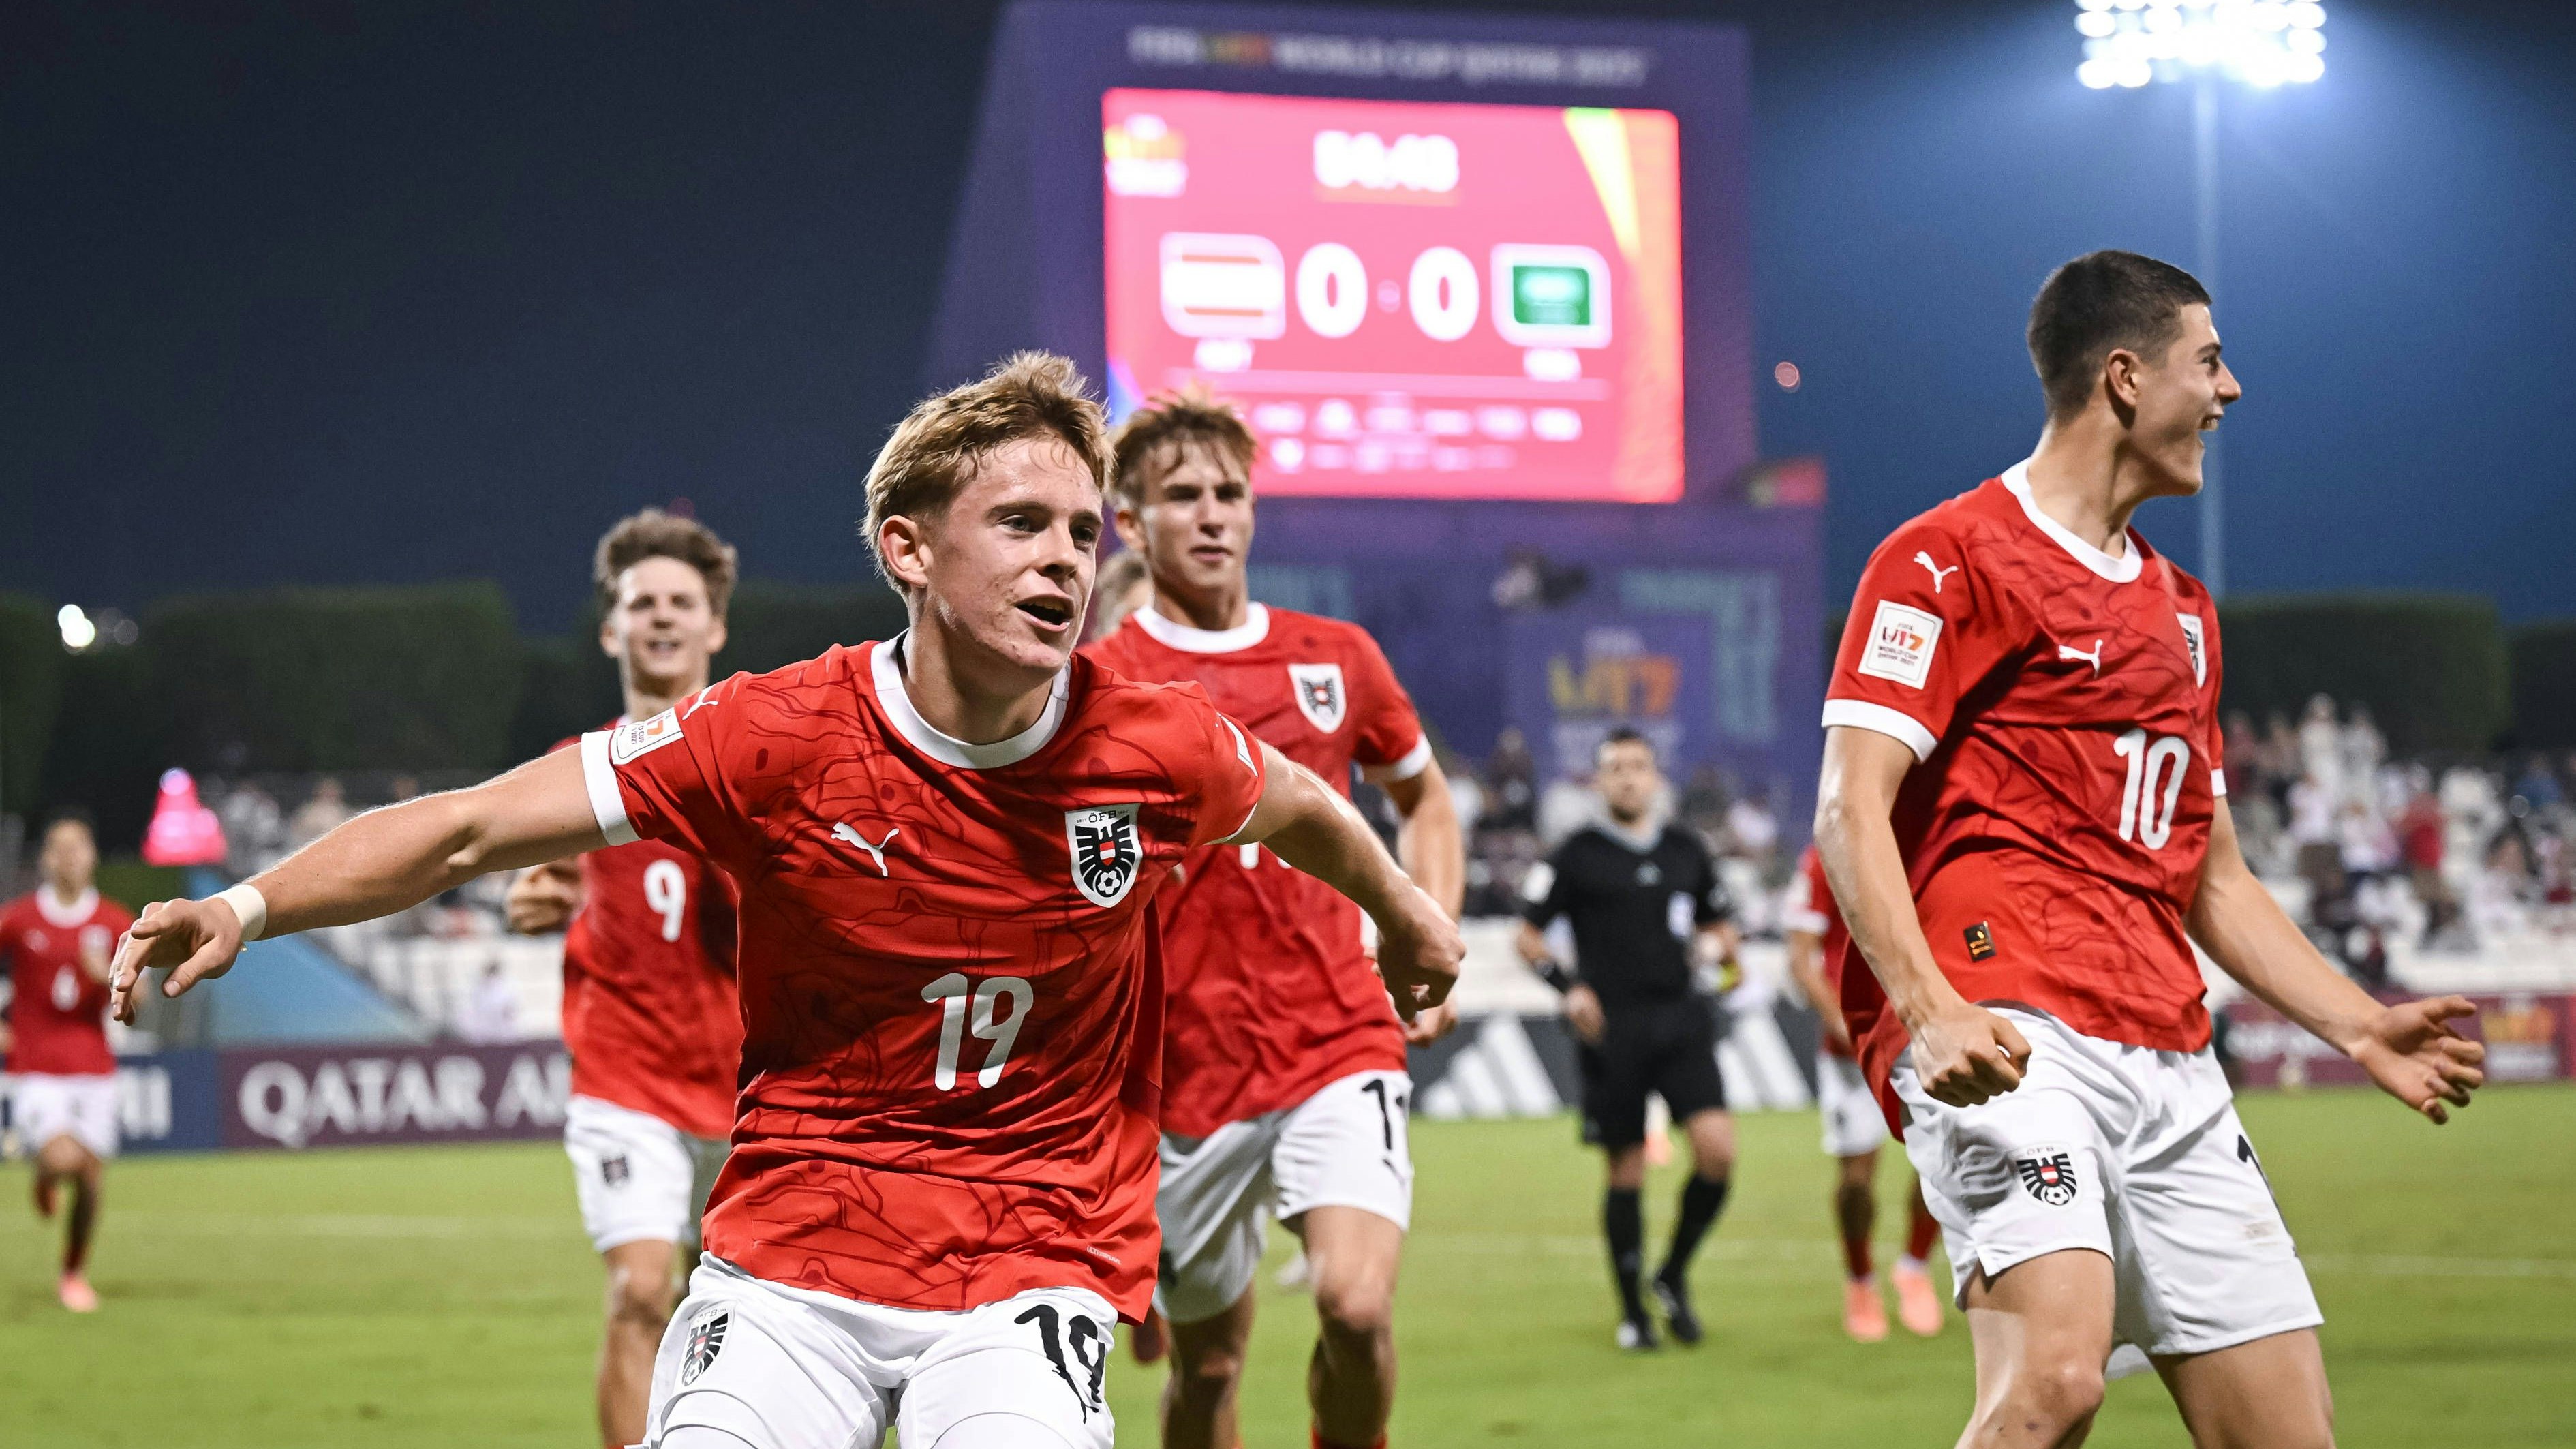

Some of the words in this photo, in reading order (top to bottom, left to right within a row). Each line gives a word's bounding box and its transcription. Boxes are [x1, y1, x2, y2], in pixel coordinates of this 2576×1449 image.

[1296, 242, 1368, 339] 0
[1408, 246, 1479, 342] 0
[1882, 626, 1924, 652] U17
[1088, 810, 1117, 823] ÖFB
[2113, 727, 2190, 850] 10
[644, 859, 686, 942] 9
[921, 973, 1034, 1091] 19
[238, 1056, 487, 1149] QATAR
[1013, 1303, 1106, 1424] 19
